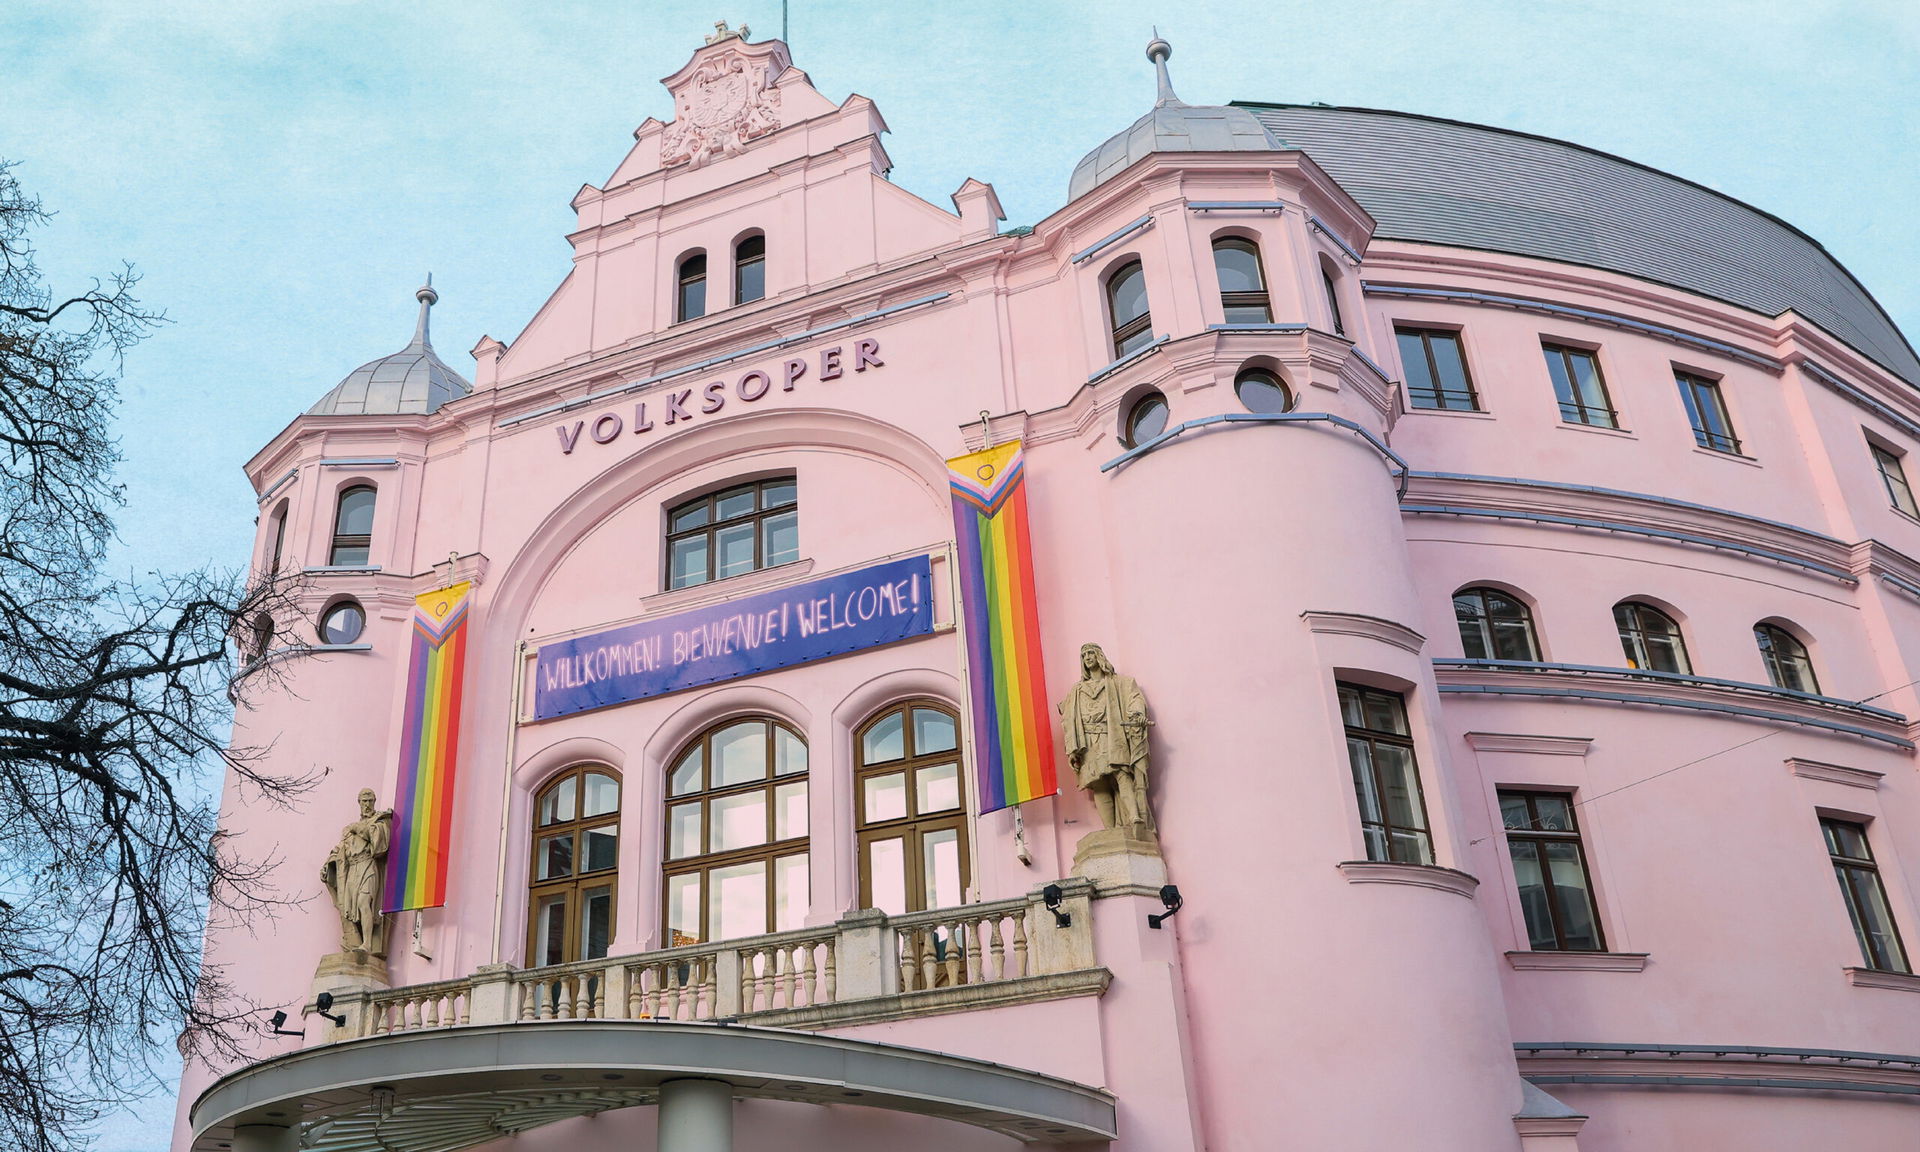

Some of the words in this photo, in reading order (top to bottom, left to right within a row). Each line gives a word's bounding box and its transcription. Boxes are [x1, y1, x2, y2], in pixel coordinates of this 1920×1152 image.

[556, 338, 884, 454] VOLKSOPER
[545, 635, 661, 691] WILLKOMMEN!
[673, 602, 787, 665] BIENVENUE!
[797, 573, 919, 638] WELCOME!
